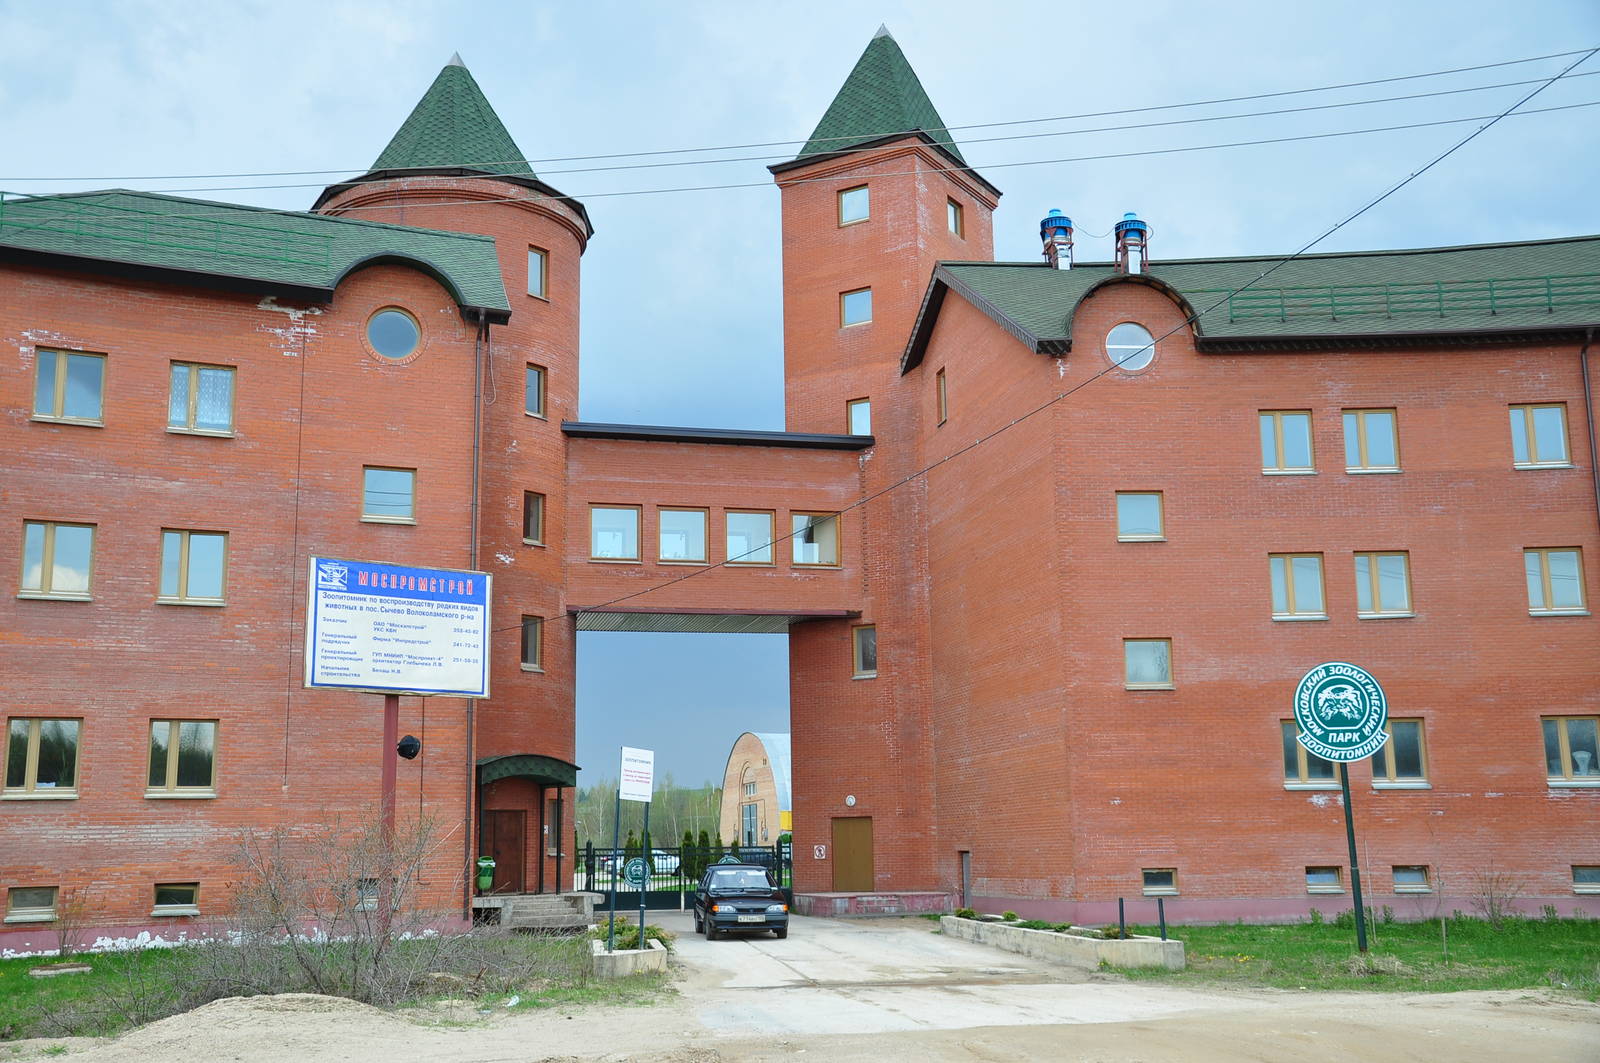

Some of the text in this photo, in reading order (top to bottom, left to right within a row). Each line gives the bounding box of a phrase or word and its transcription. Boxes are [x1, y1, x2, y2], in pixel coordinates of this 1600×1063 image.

[358, 571, 473, 595] МОСПРОМСТРОЙ
[322, 592, 367, 602] Зоопитомник
[379, 598, 434, 609] воспроизводству
[436, 602, 459, 610] редких
[325, 603, 357, 611] животных
[406, 609, 459, 618] Волоколамского
[1300, 666, 1327, 737] МОСКОВСКИЙ
[1328, 666, 1381, 737] ЗООЛОГИЧЕСКИЙ
[1300, 732, 1385, 760] ЗООПИТОМНИК
[1328, 732, 1361, 743] ПАРК
